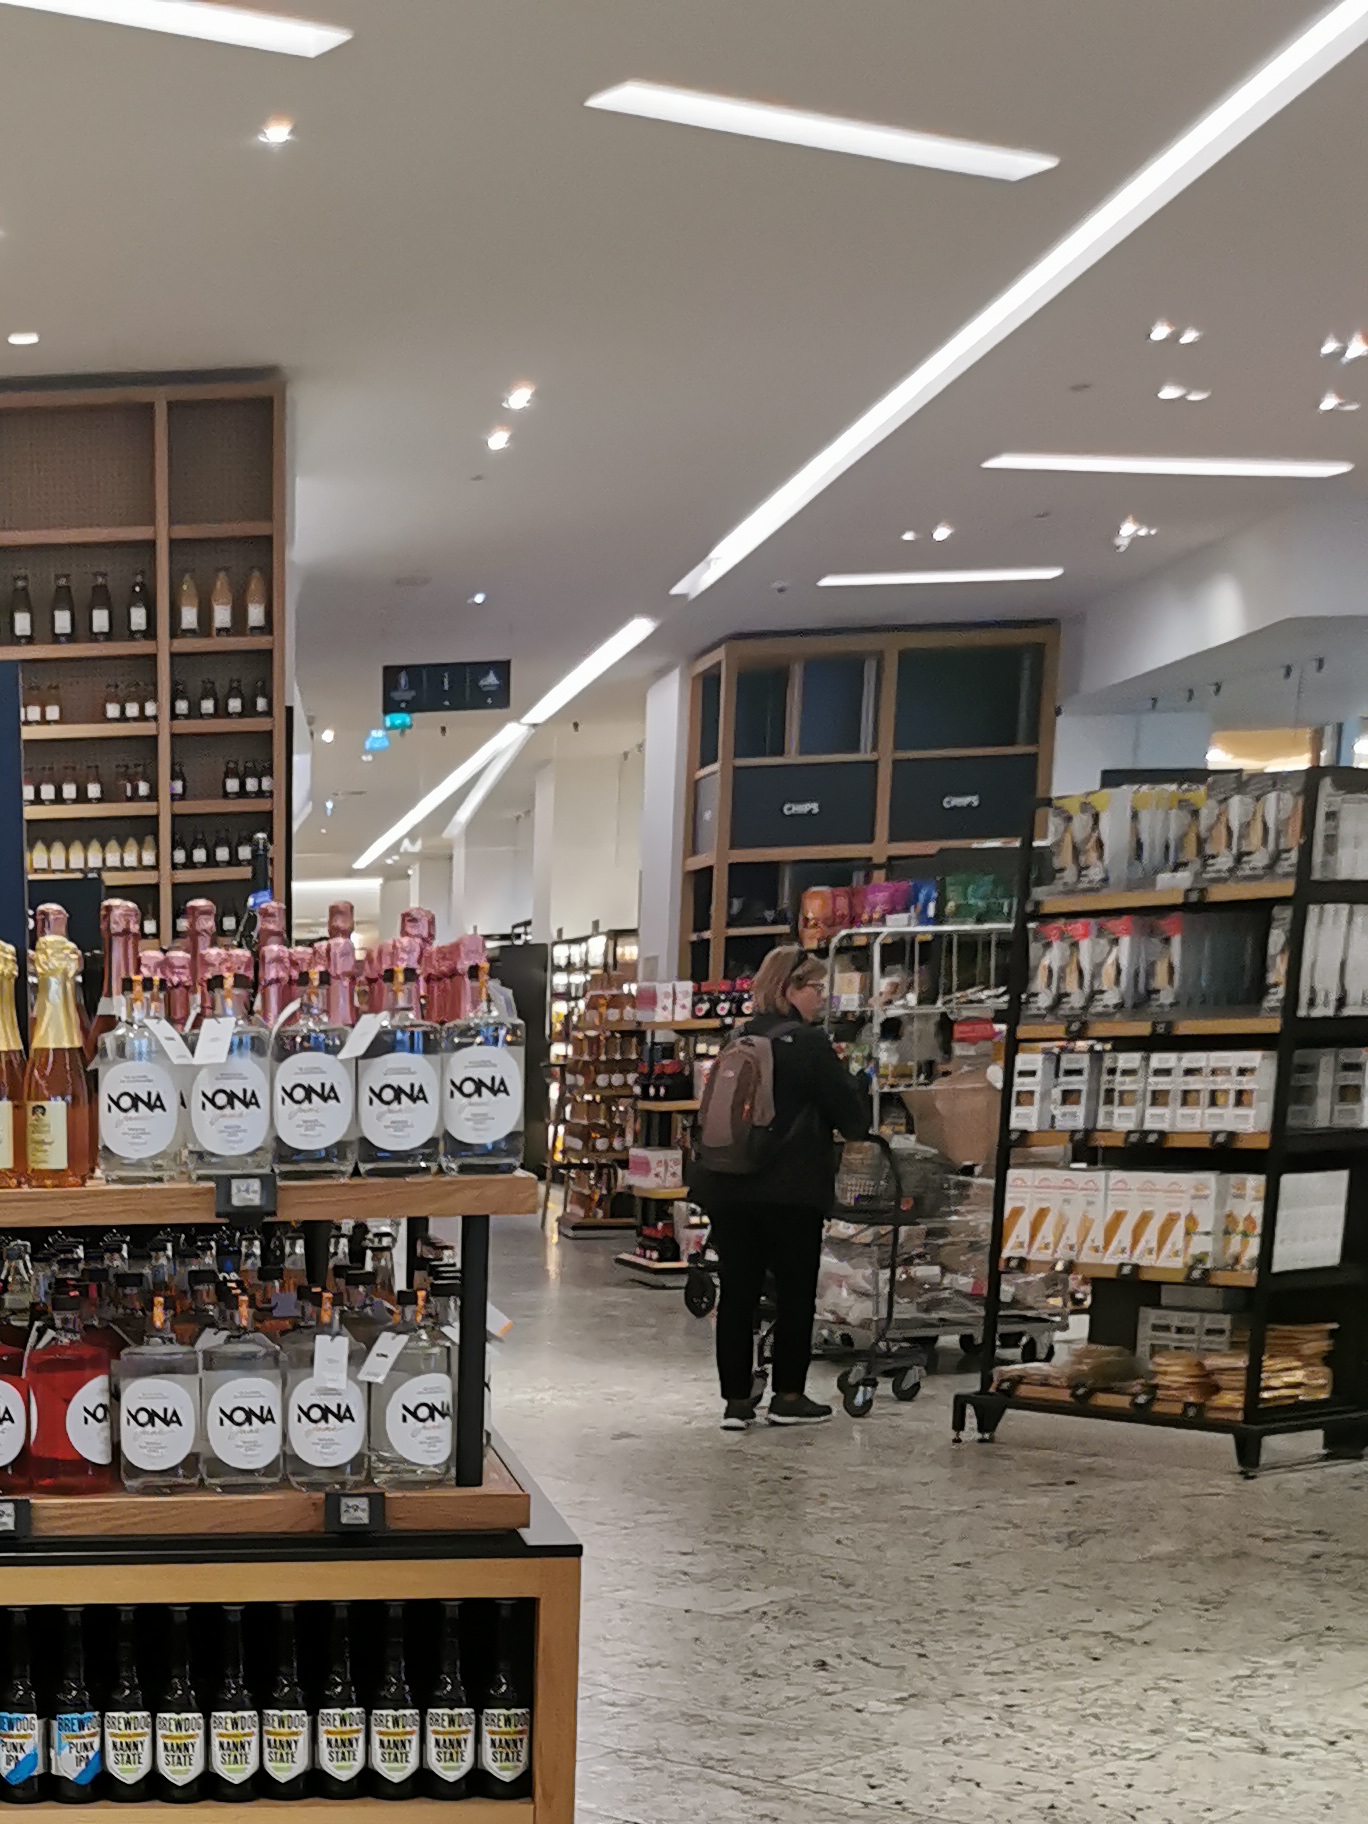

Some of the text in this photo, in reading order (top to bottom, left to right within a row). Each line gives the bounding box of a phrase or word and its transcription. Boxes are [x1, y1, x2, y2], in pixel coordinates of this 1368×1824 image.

[782, 801, 820, 816] CHIPS
[943, 794, 980, 809] CHIPS
[281, 1081, 341, 1106] NONA
[449, 1074, 511, 1099] NONA
[201, 1087, 261, 1112] NONA
[369, 1081, 429, 1107] NONA
[107, 1090, 167, 1114] NONA
[126, 1405, 183, 1428] NONA
[218, 1404, 277, 1428] NONA
[296, 1402, 356, 1425] NONA
[106, 1714, 152, 1731] BREWDOG
[157, 1715, 203, 1732] BREWDOG
[212, 1714, 258, 1731] BREWDOG
[262, 1713, 307, 1730] BREWDOG
[320, 1711, 366, 1728] BREWDOG
[373, 1711, 420, 1729] BREWDOG
[428, 1711, 475, 1728] BREWDOG
[483, 1711, 531, 1728] BREWDOG
[0, 1740, 27, 1754] PUNK
[68, 1740, 95, 1754] PUNK
[112, 1740, 146, 1752] NANNY
[162, 1741, 198, 1754] NANNY
[217, 1740, 253, 1752] NANNY
[266, 1737, 299, 1751] NANNY
[325, 1736, 360, 1750] NANNY
[378, 1737, 413, 1751] NANNY
[433, 1736, 468, 1750] NANNY
[489, 1737, 525, 1750] NANNY
[5, 1754, 22, 1767] IPA
[74, 1754, 91, 1768] IPA
[113, 1751, 144, 1766] STATE
[164, 1753, 195, 1767] STATE
[220, 1752, 251, 1766] STATE
[267, 1750, 297, 1764] STATE
[327, 1749, 358, 1763] STATE
[381, 1750, 412, 1764] STATE
[435, 1750, 466, 1763] STATE
[491, 1749, 523, 1763] STATE
